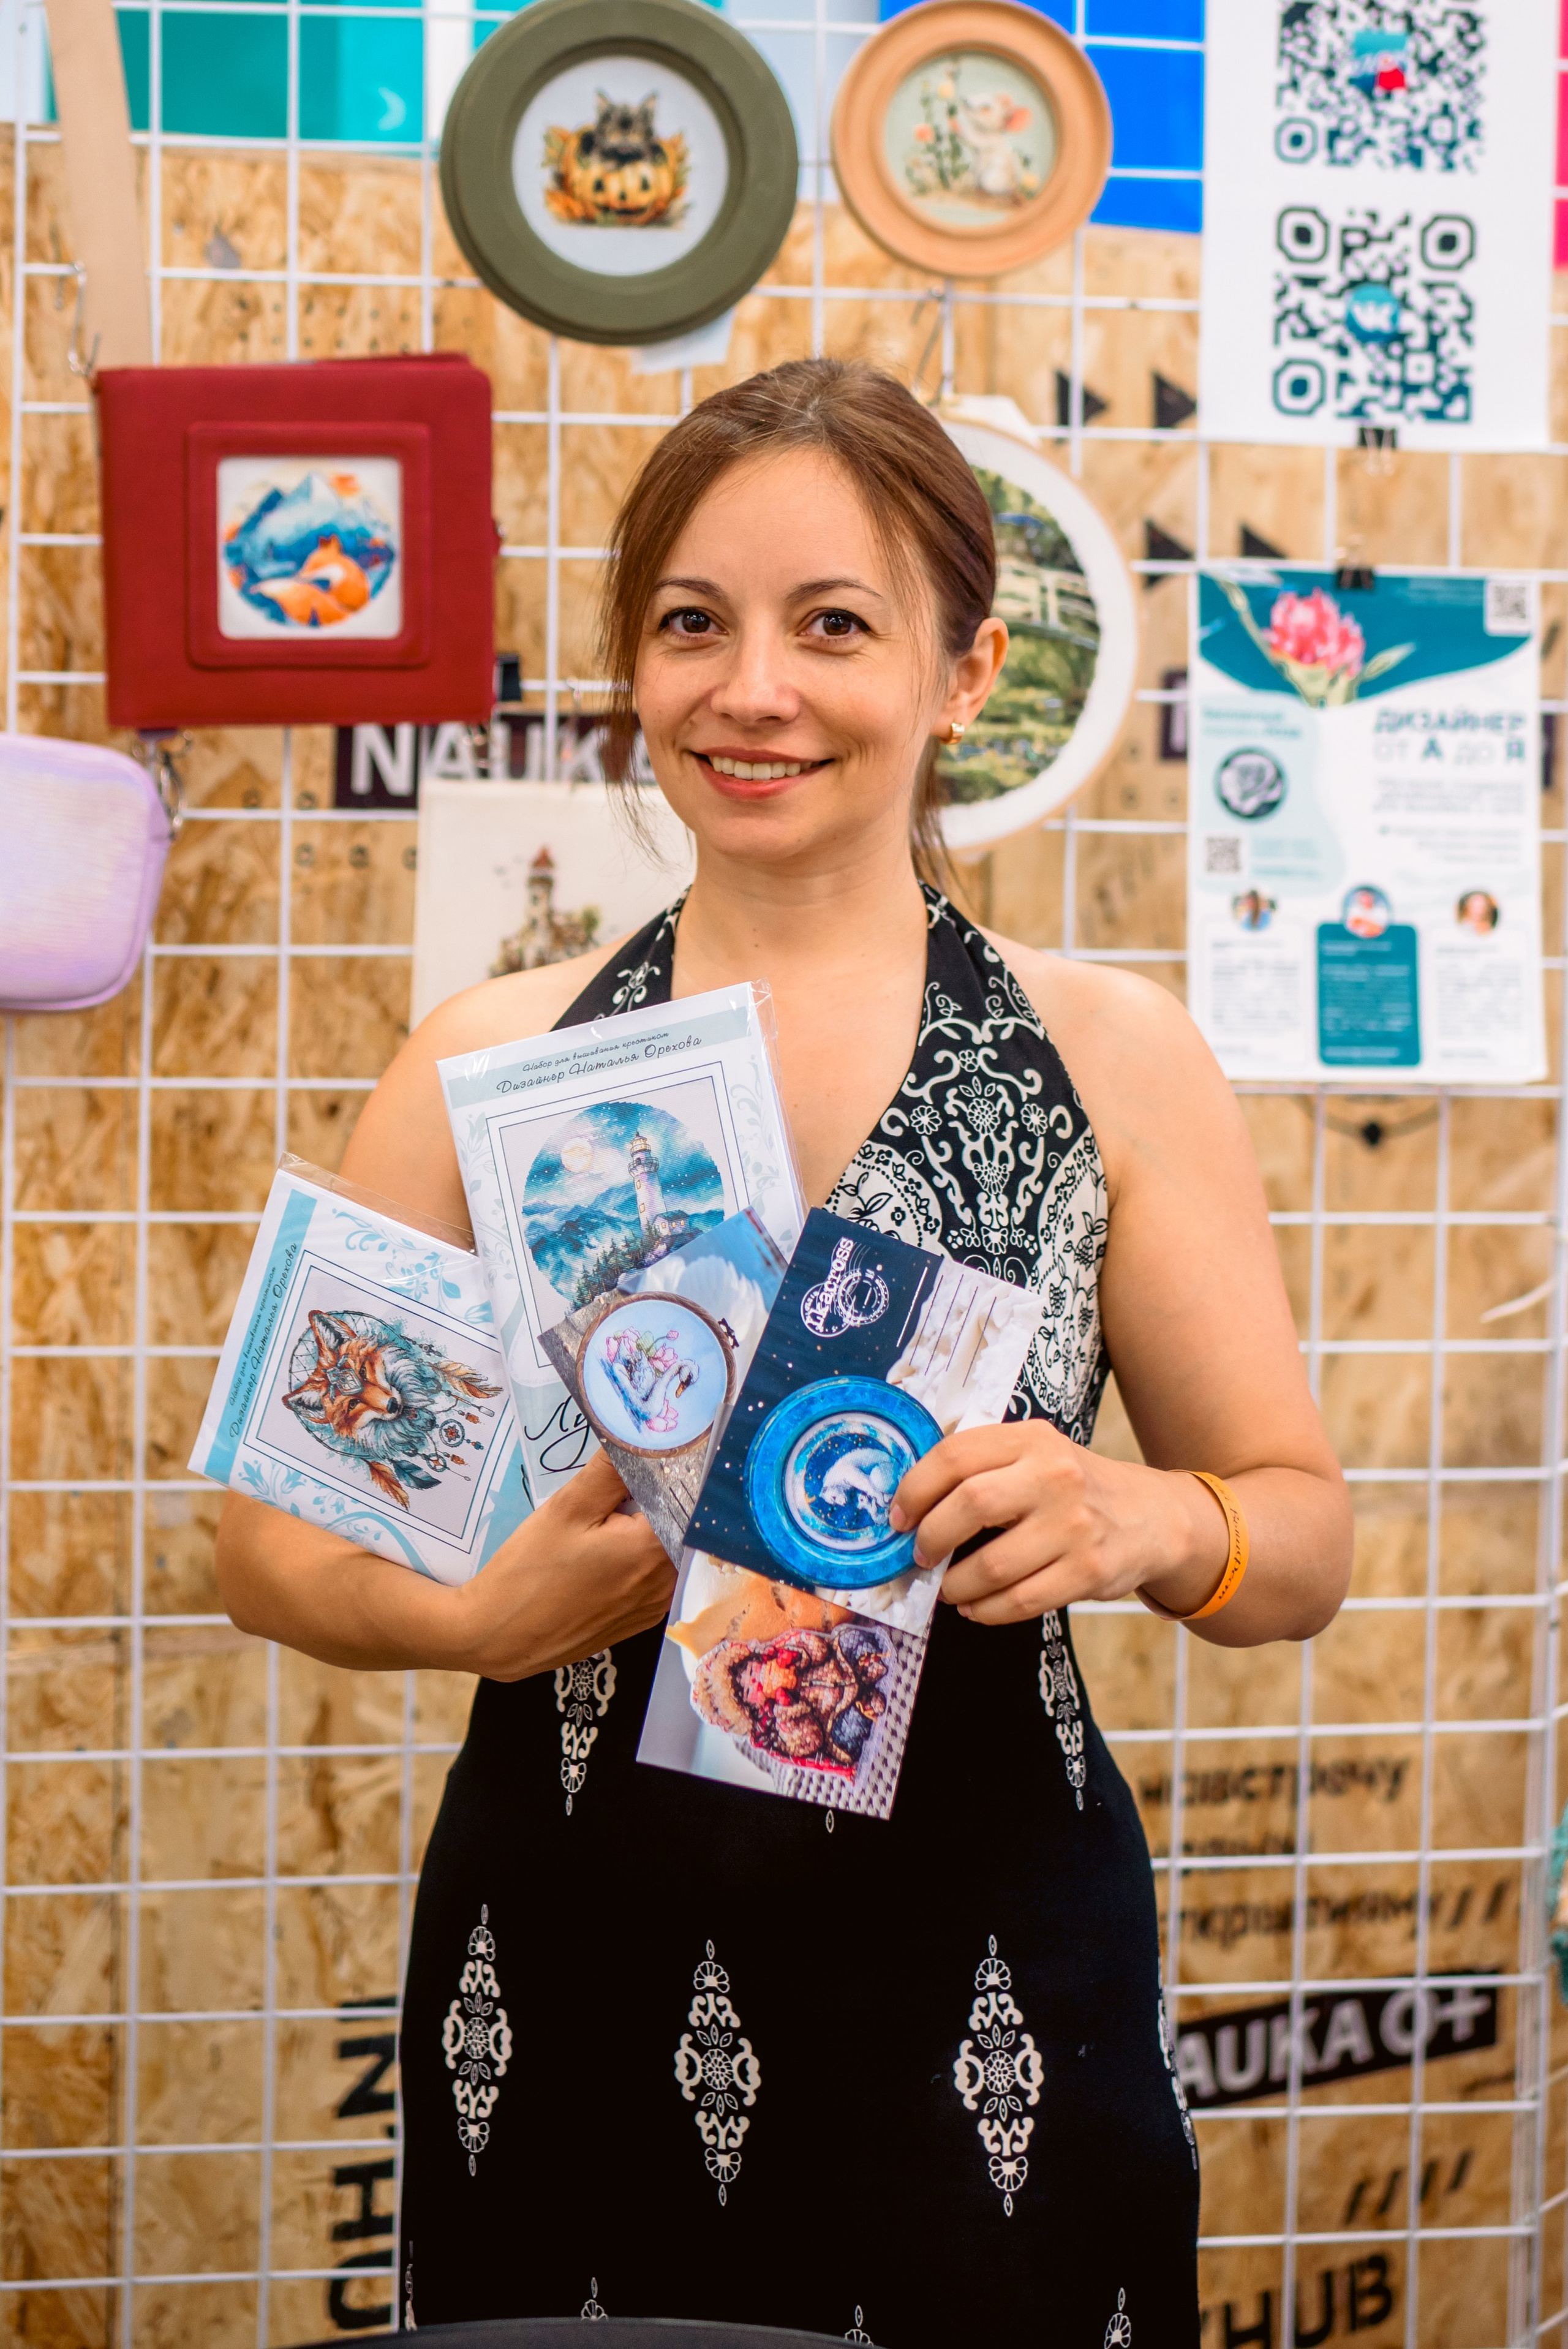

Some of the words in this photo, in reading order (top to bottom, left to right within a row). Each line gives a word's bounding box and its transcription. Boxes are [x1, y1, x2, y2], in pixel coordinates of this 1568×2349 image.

[496, 1071, 565, 1093] Дизайнер
[568, 1054, 640, 1076] Наталья
[644, 1035, 702, 1058] Орехова
[522, 1060, 552, 1072] Набор
[554, 1057, 570, 1067] для
[572, 1043, 620, 1060] вышивания
[229, 1372, 258, 1438] Дизайнер
[251, 1302, 279, 1371] Наталья
[272, 1242, 297, 1299] Орехова
[229, 1376, 243, 1407] Набор
[1176, 1998, 1374, 2099] AUKA
